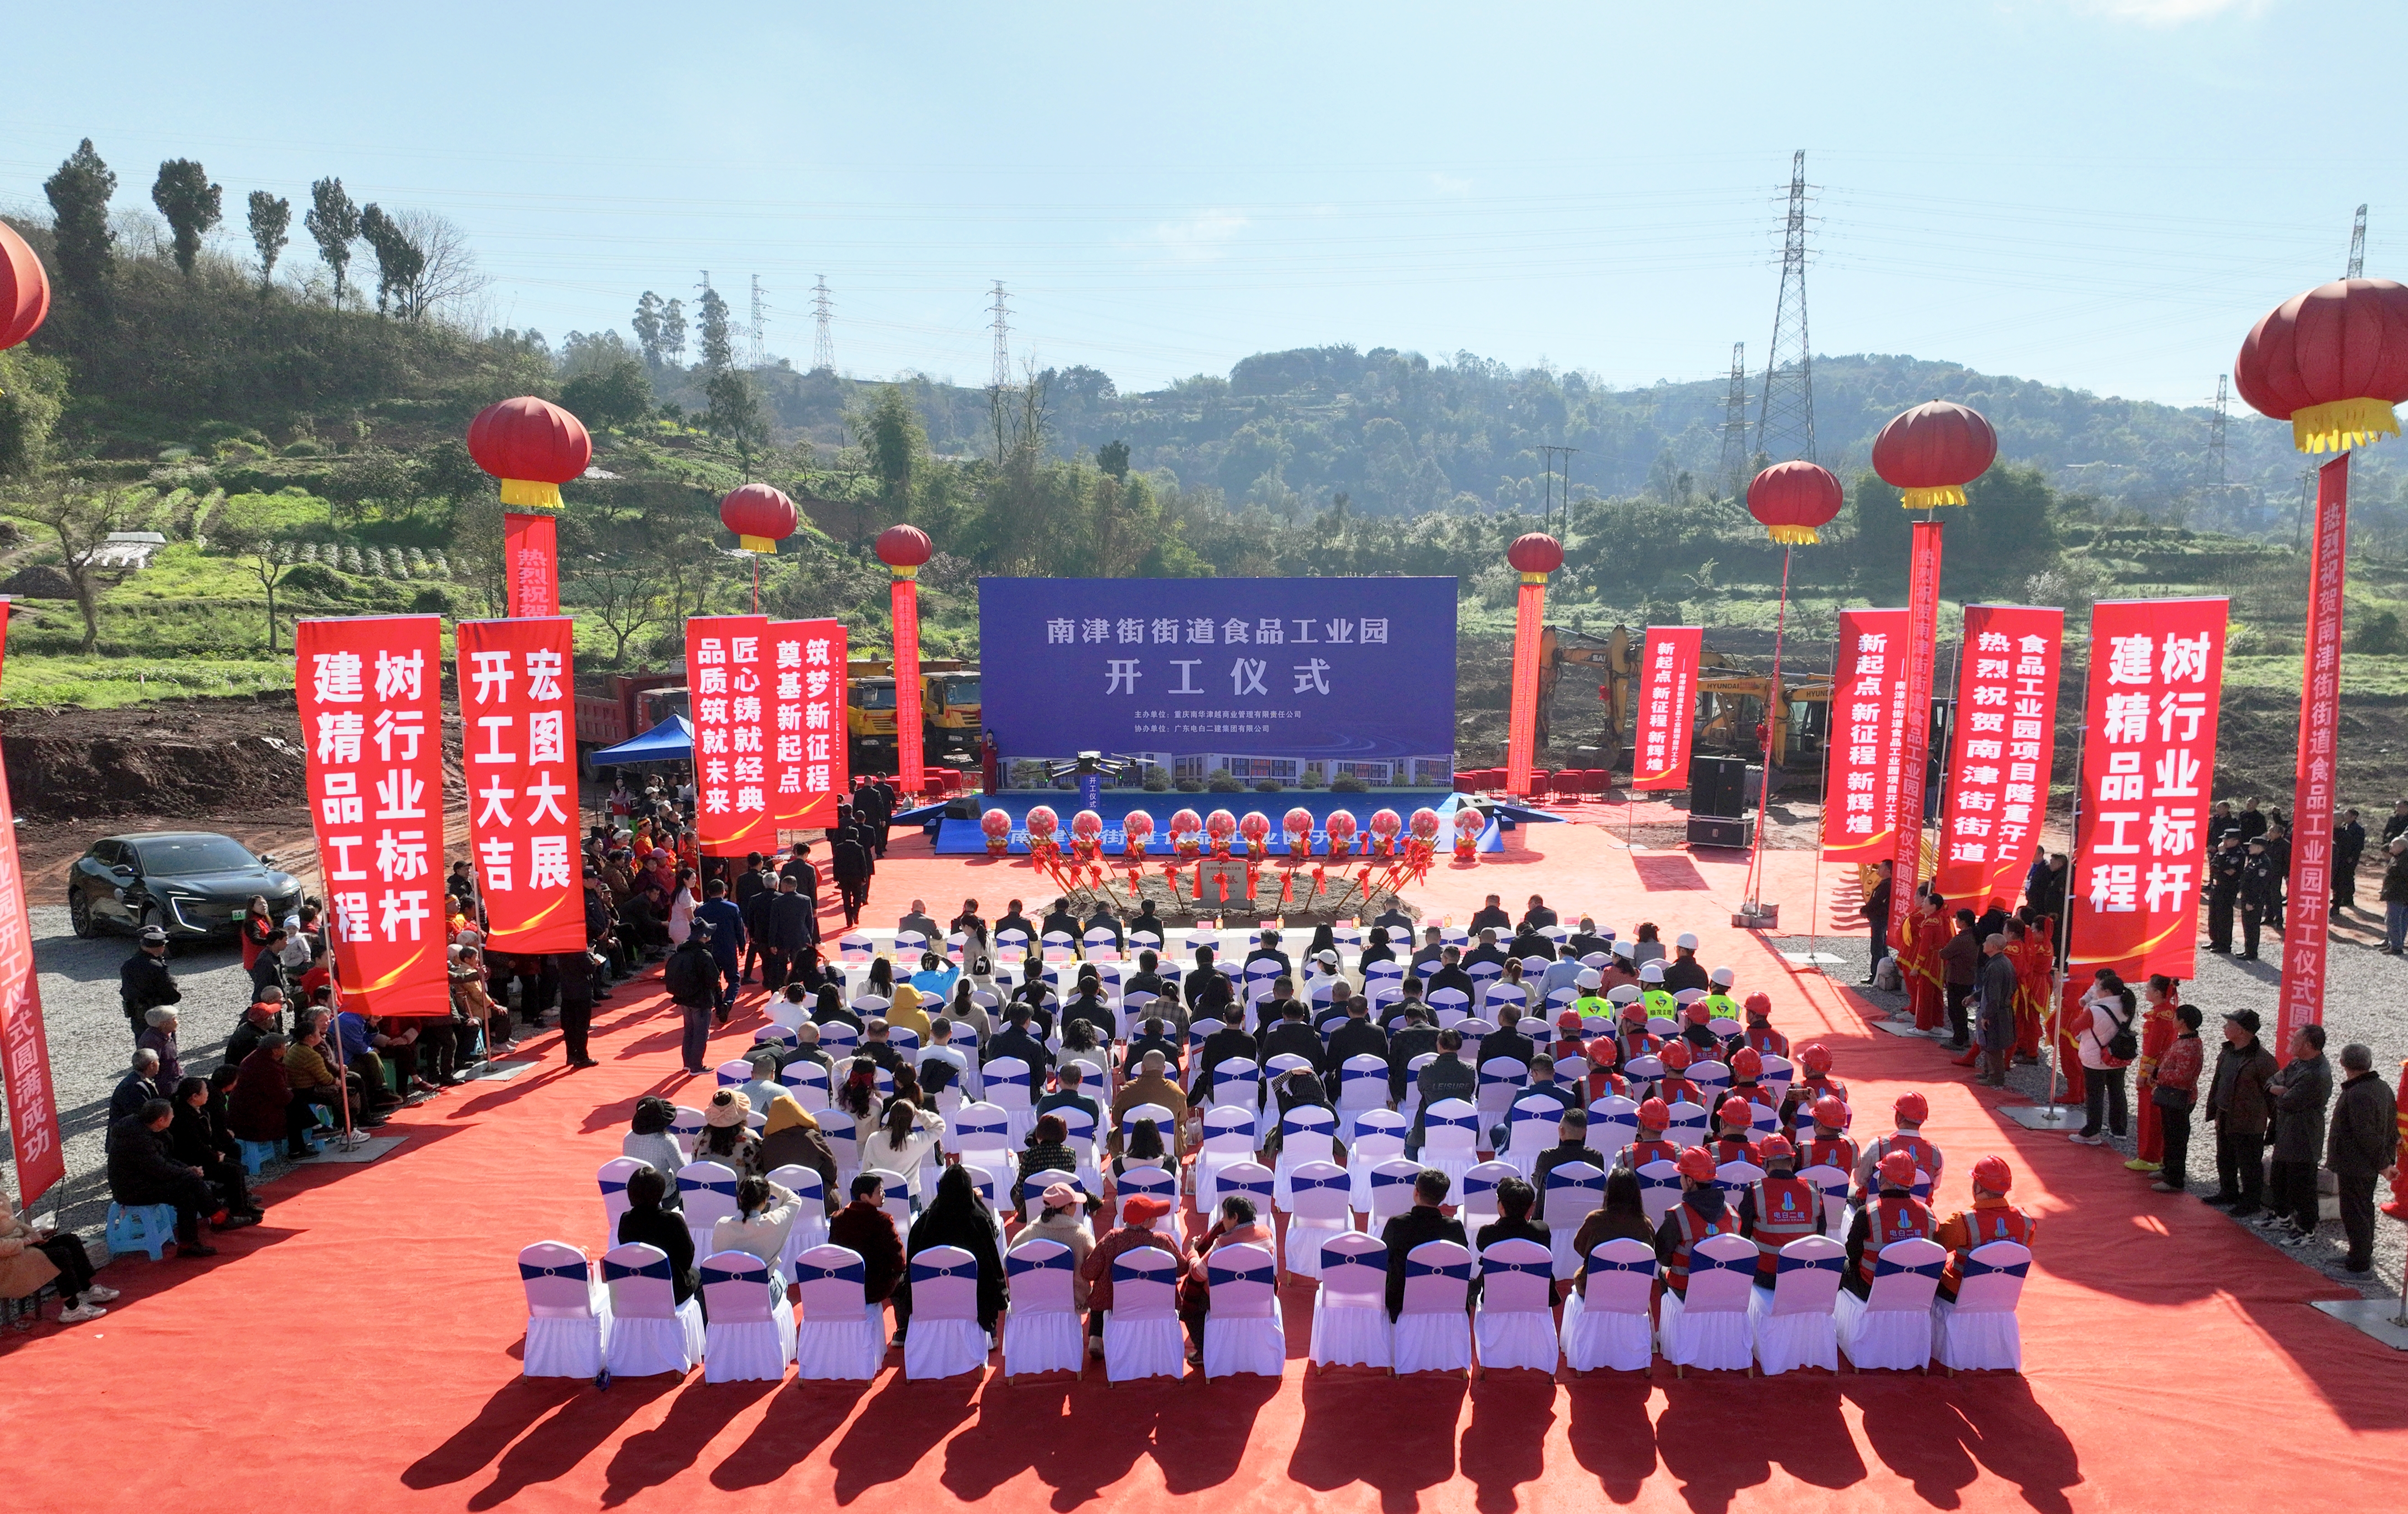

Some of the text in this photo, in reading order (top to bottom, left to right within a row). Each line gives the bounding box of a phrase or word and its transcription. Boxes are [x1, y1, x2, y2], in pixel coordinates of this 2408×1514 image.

[697, 638, 730, 814] 品质筑就未来
[732, 636, 765, 813] 匠心铸就经典
[776, 640, 802, 793] 奠基新起点
[806, 638, 830, 792] 筑梦新征程
[1047, 618, 1388, 644] 南津街街道食品工业园
[1105, 658, 1330, 695] 开工仪式
[1646, 642, 1675, 771] 新起点 新征程 新辉煌
[1846, 633, 1887, 834] 新起点 新征程 新辉煌
[313, 651, 371, 943] 建精品工程
[374, 649, 430, 942] 树行业标杆
[471, 651, 516, 891] 开工大吉
[526, 648, 571, 889] 宏图大展
[1950, 632, 2012, 862] 热烈祝贺南津街街道
[1994, 634, 2049, 863] 食品工业园项目隆重开工
[2089, 633, 2154, 913] 建精品工程
[2145, 632, 2211, 913] 树行业标杆
[2286, 505, 2341, 1042] 热烈祝贺南津街街道食品工业园开工仪式圆
